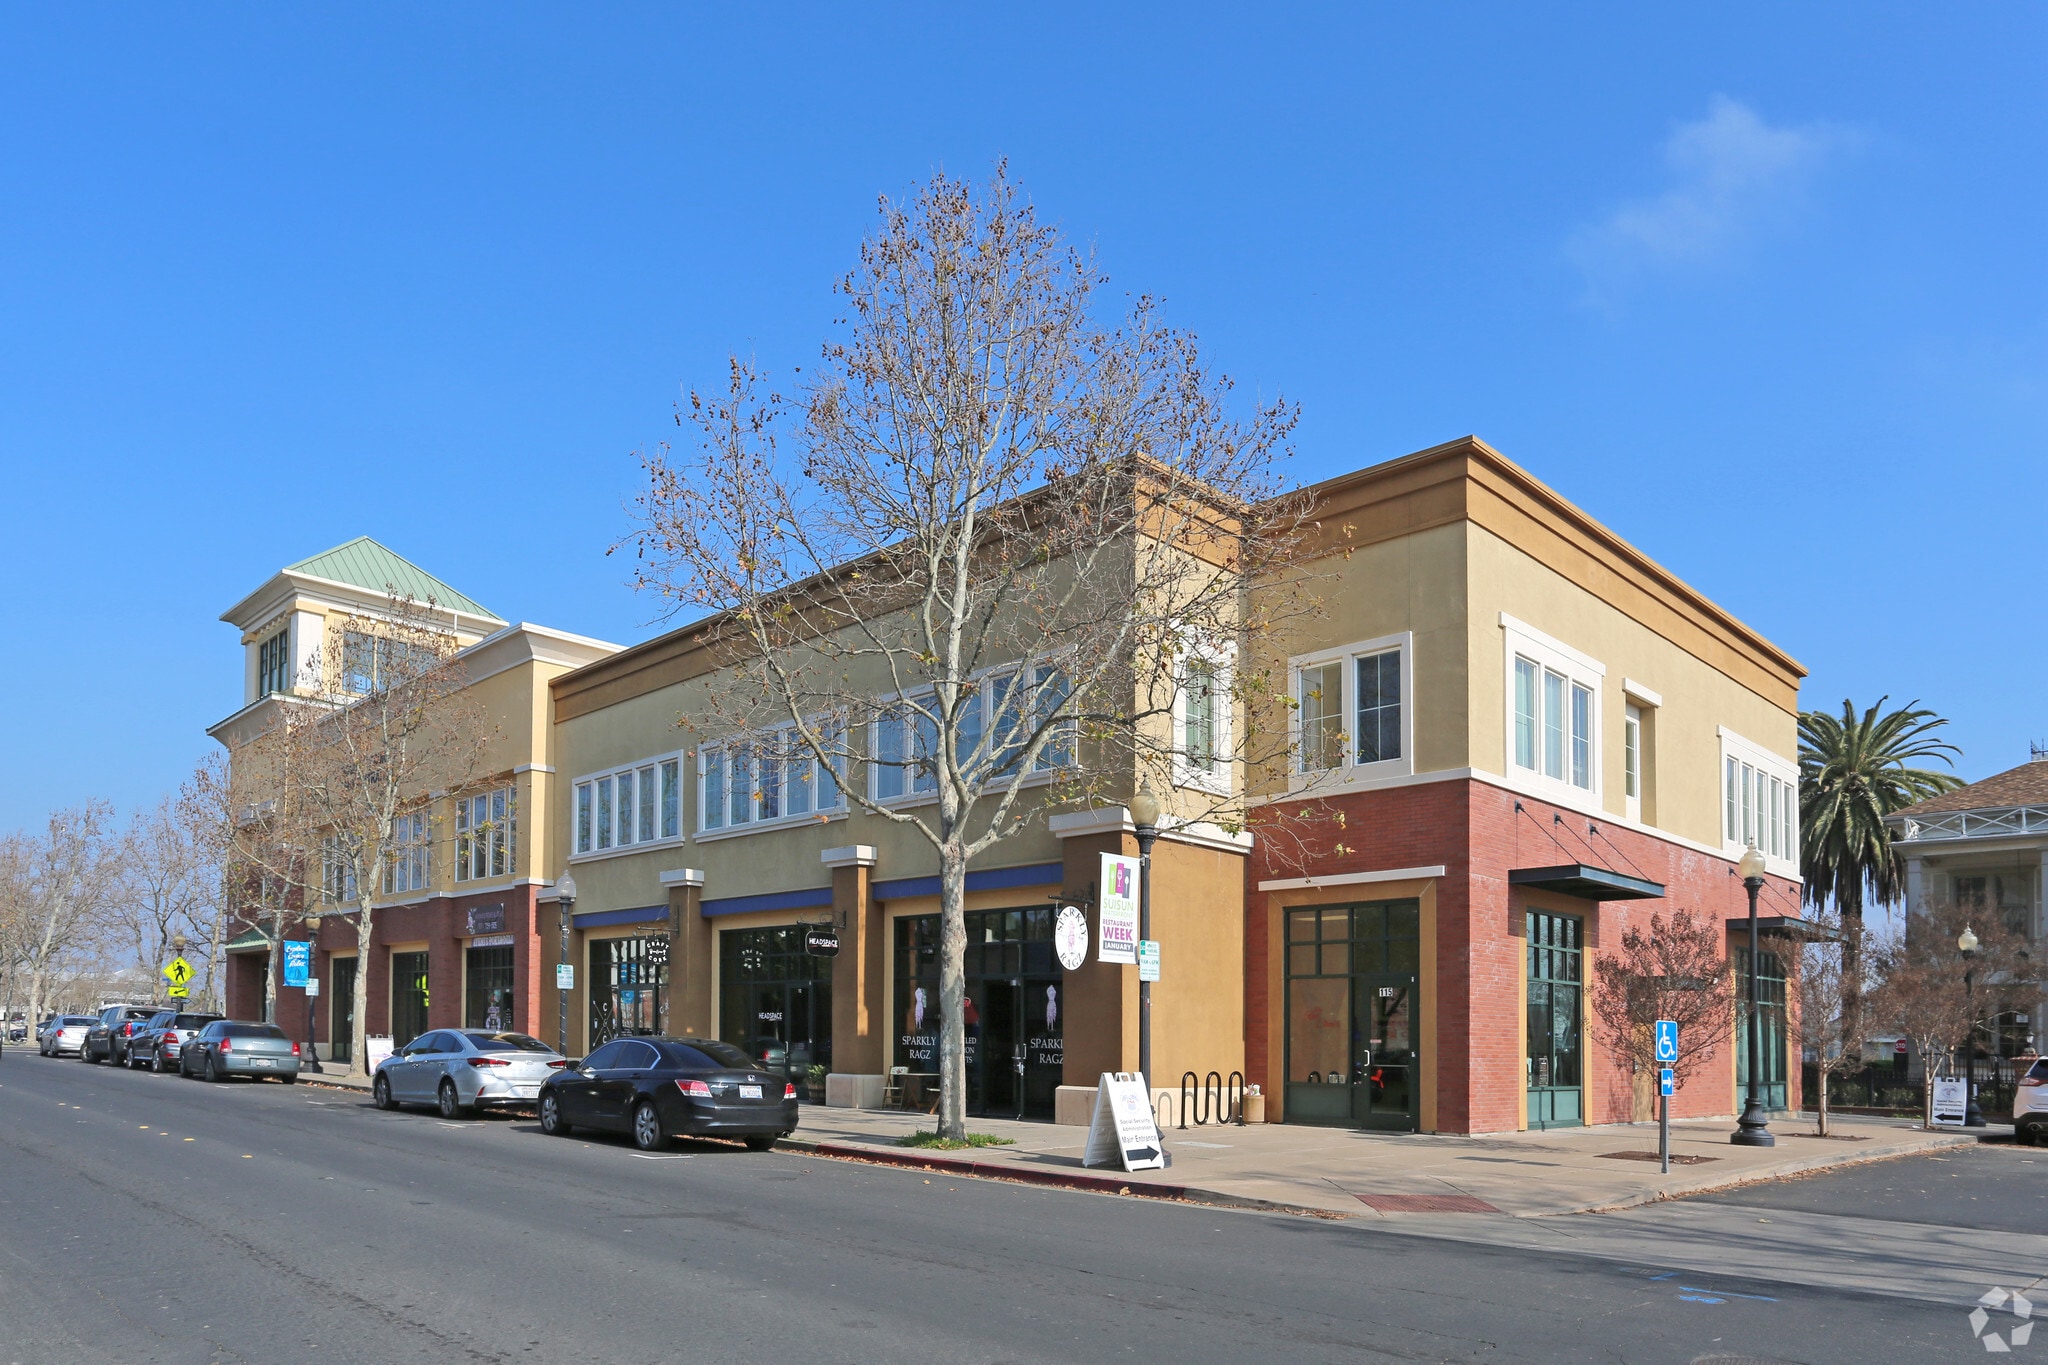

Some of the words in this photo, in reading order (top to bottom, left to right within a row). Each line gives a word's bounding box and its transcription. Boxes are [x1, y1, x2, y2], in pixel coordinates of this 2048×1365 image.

[1103, 898, 1134, 911] SUISUN
[1103, 910, 1133, 918] WATERFRONT
[1057, 908, 1087, 936] SPARKLY
[1102, 919, 1133, 927] RESTAURANT
[1103, 926, 1133, 941] WEEK
[646, 941, 669, 949] CRAFT
[808, 938, 838, 947] HEADSPACE
[1104, 942, 1132, 951] JANUARY
[1060, 953, 1082, 967] RAGZ
[1379, 988, 1393, 997] 115
[902, 1036, 936, 1046] SPARKLY
[909, 1049, 931, 1060] RAGZ
